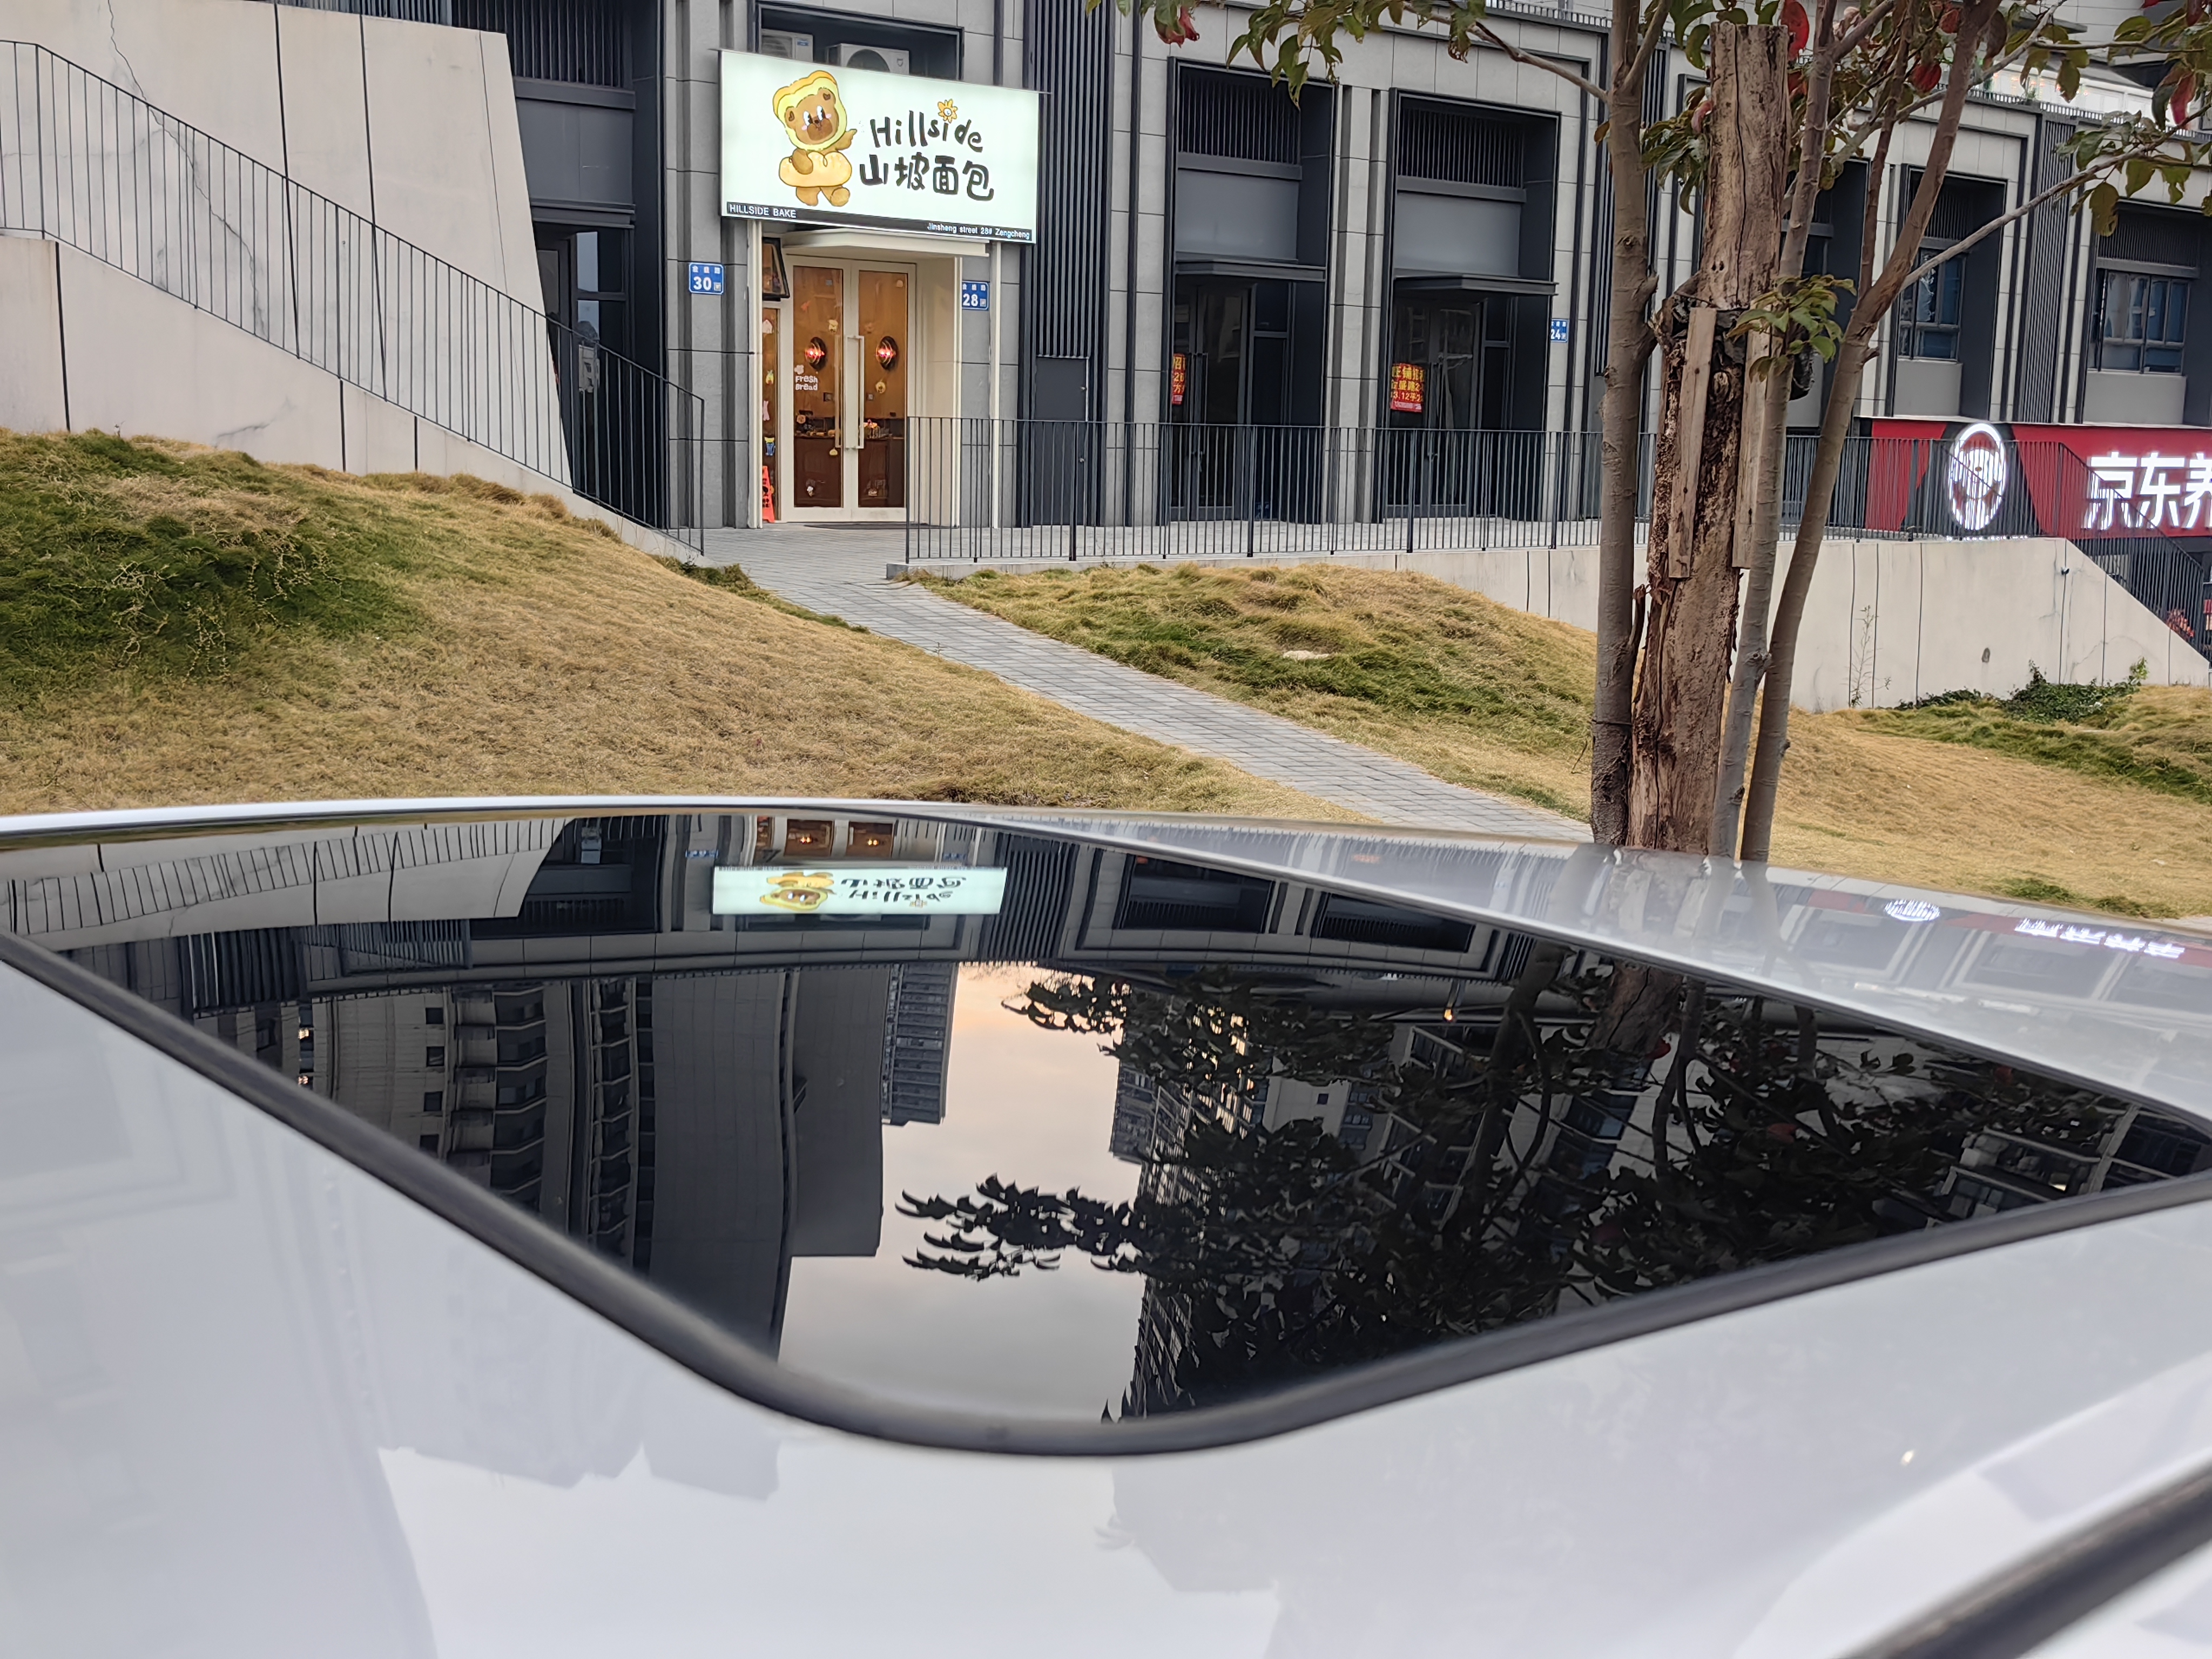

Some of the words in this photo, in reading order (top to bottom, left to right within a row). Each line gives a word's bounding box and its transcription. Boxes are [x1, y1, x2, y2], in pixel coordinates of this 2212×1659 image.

[870, 110, 983, 153] Hillside
[859, 152, 994, 201] 山坡面包
[729, 204, 770, 216] HILLSIDE
[773, 208, 797, 218] BAKE
[927, 222, 957, 234] Jinsheng
[959, 226, 978, 234] street
[995, 228, 1030, 240] Zengcheng
[693, 276, 712, 291] 30
[962, 293, 979, 307] 28
[1550, 328, 1561, 340] 24
[795, 375, 818, 383] Fresh
